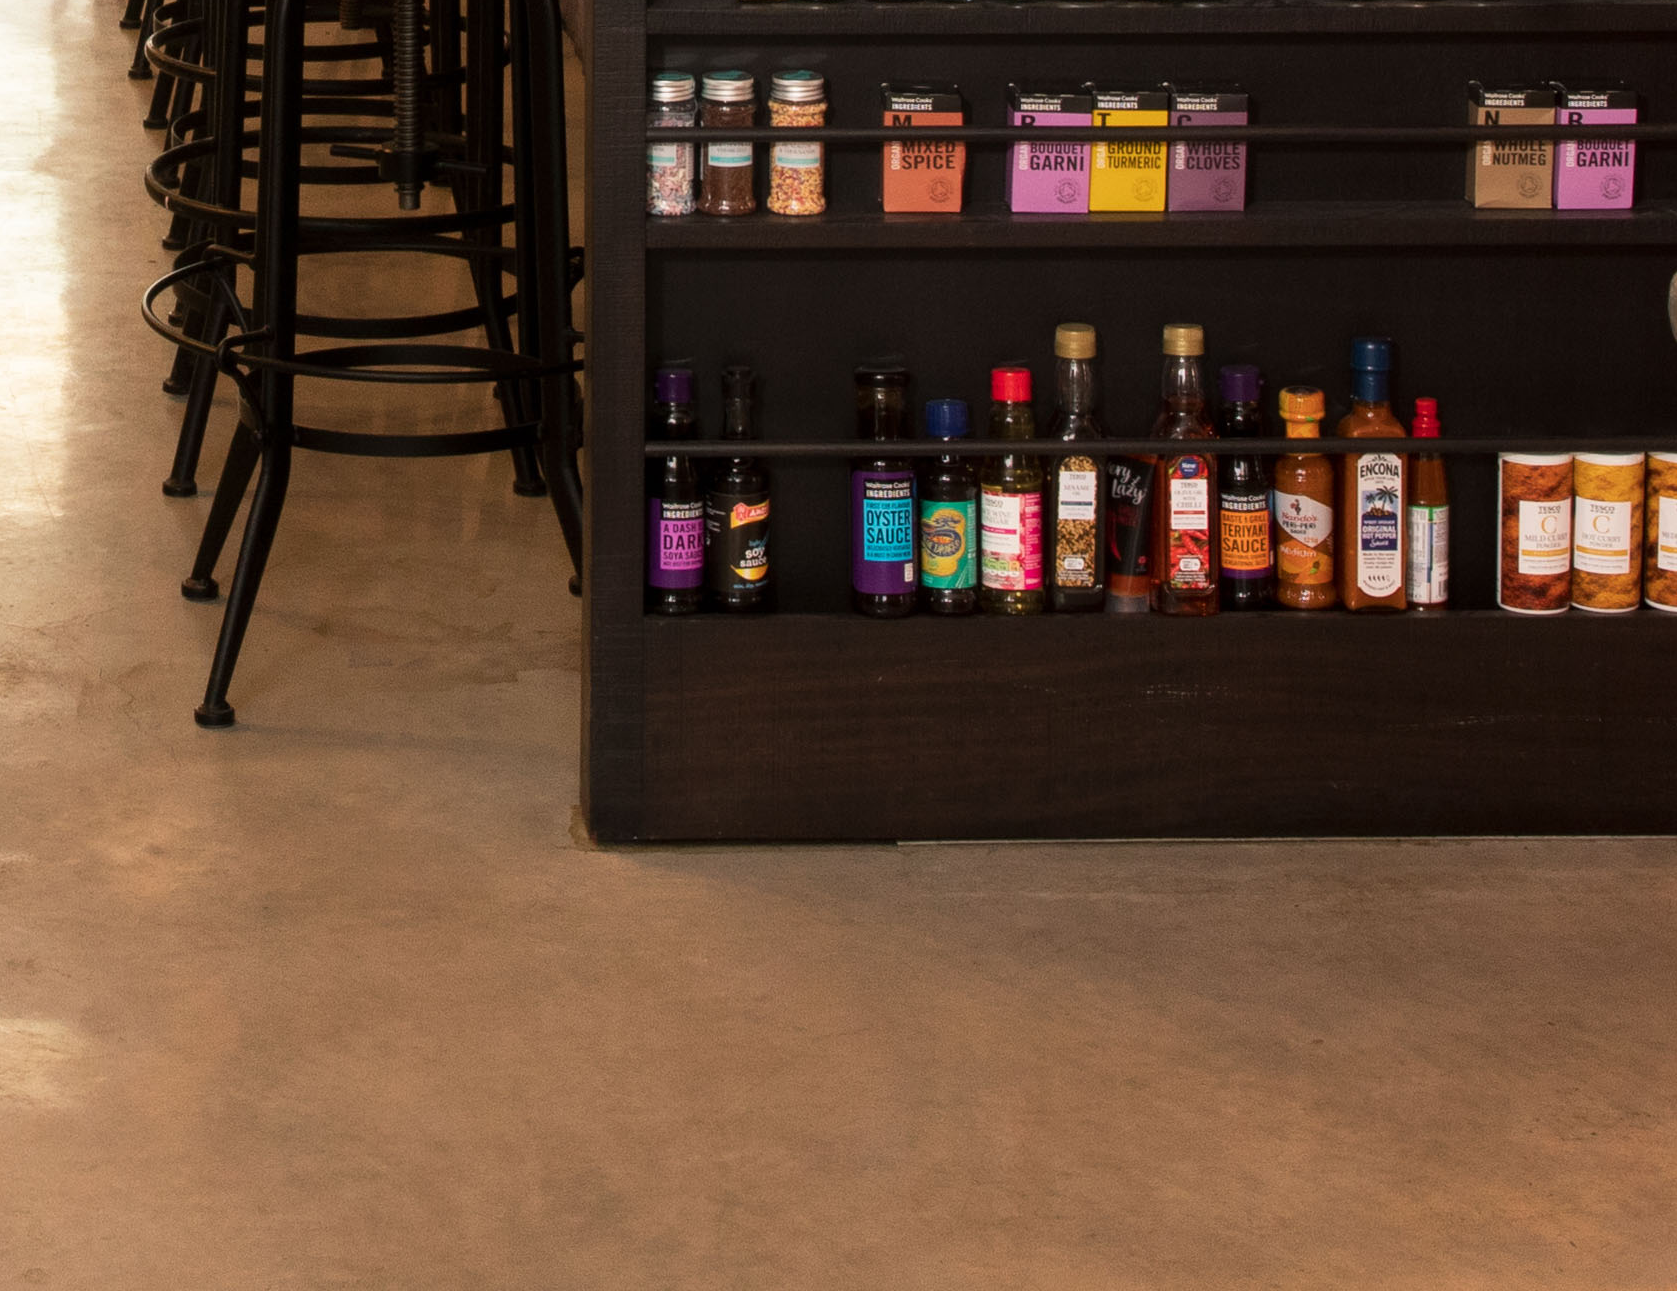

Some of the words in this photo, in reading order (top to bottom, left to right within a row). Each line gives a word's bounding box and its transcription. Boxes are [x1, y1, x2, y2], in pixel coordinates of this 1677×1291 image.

[902, 141, 956, 155] MIXED
[1030, 142, 1086, 155] BOUQUET
[1107, 142, 1162, 155] GROUND
[1187, 142, 1241, 156] WHOLE
[1494, 139, 1546, 152] WHOLE
[1577, 139, 1630, 151] BOUQUET
[902, 155, 956, 170] SPICE
[1030, 155, 1085, 171] GARNI
[1107, 156, 1162, 169] TURMERIC
[1186, 155, 1241, 170] CLOVES
[1493, 153, 1547, 167] NUTMEG
[1577, 151, 1630, 167] GARNI
[1360, 462, 1400, 479] ENCONA
[865, 482, 893, 490] Waitrose
[1111, 478, 1148, 506] Lazy
[866, 489, 911, 498] INGREDIENTS
[1222, 500, 1266, 511] INGREDIENTS
[866, 509, 911, 527] OYSTER
[1282, 511, 1317, 523] Nando's
[663, 523, 671, 534] A
[672, 523, 696, 534] DASH
[1222, 522, 1267, 538] TERIYAKI
[1282, 520, 1317, 530] PERI-PERI
[1362, 524, 1397, 534] ORIGINAL
[1541, 515, 1558, 534] C
[1592, 515, 1611, 534] C
[866, 526, 911, 544] SAUCE
[1362, 532, 1375, 540] HOT
[1374, 532, 1397, 540] PEPPER
[1222, 537, 1267, 553] SAUCE
[1279, 545, 1317, 558] Medium
[663, 551, 684, 560] SOYA
[744, 546, 766, 560] soy
[740, 557, 768, 569] sauce
